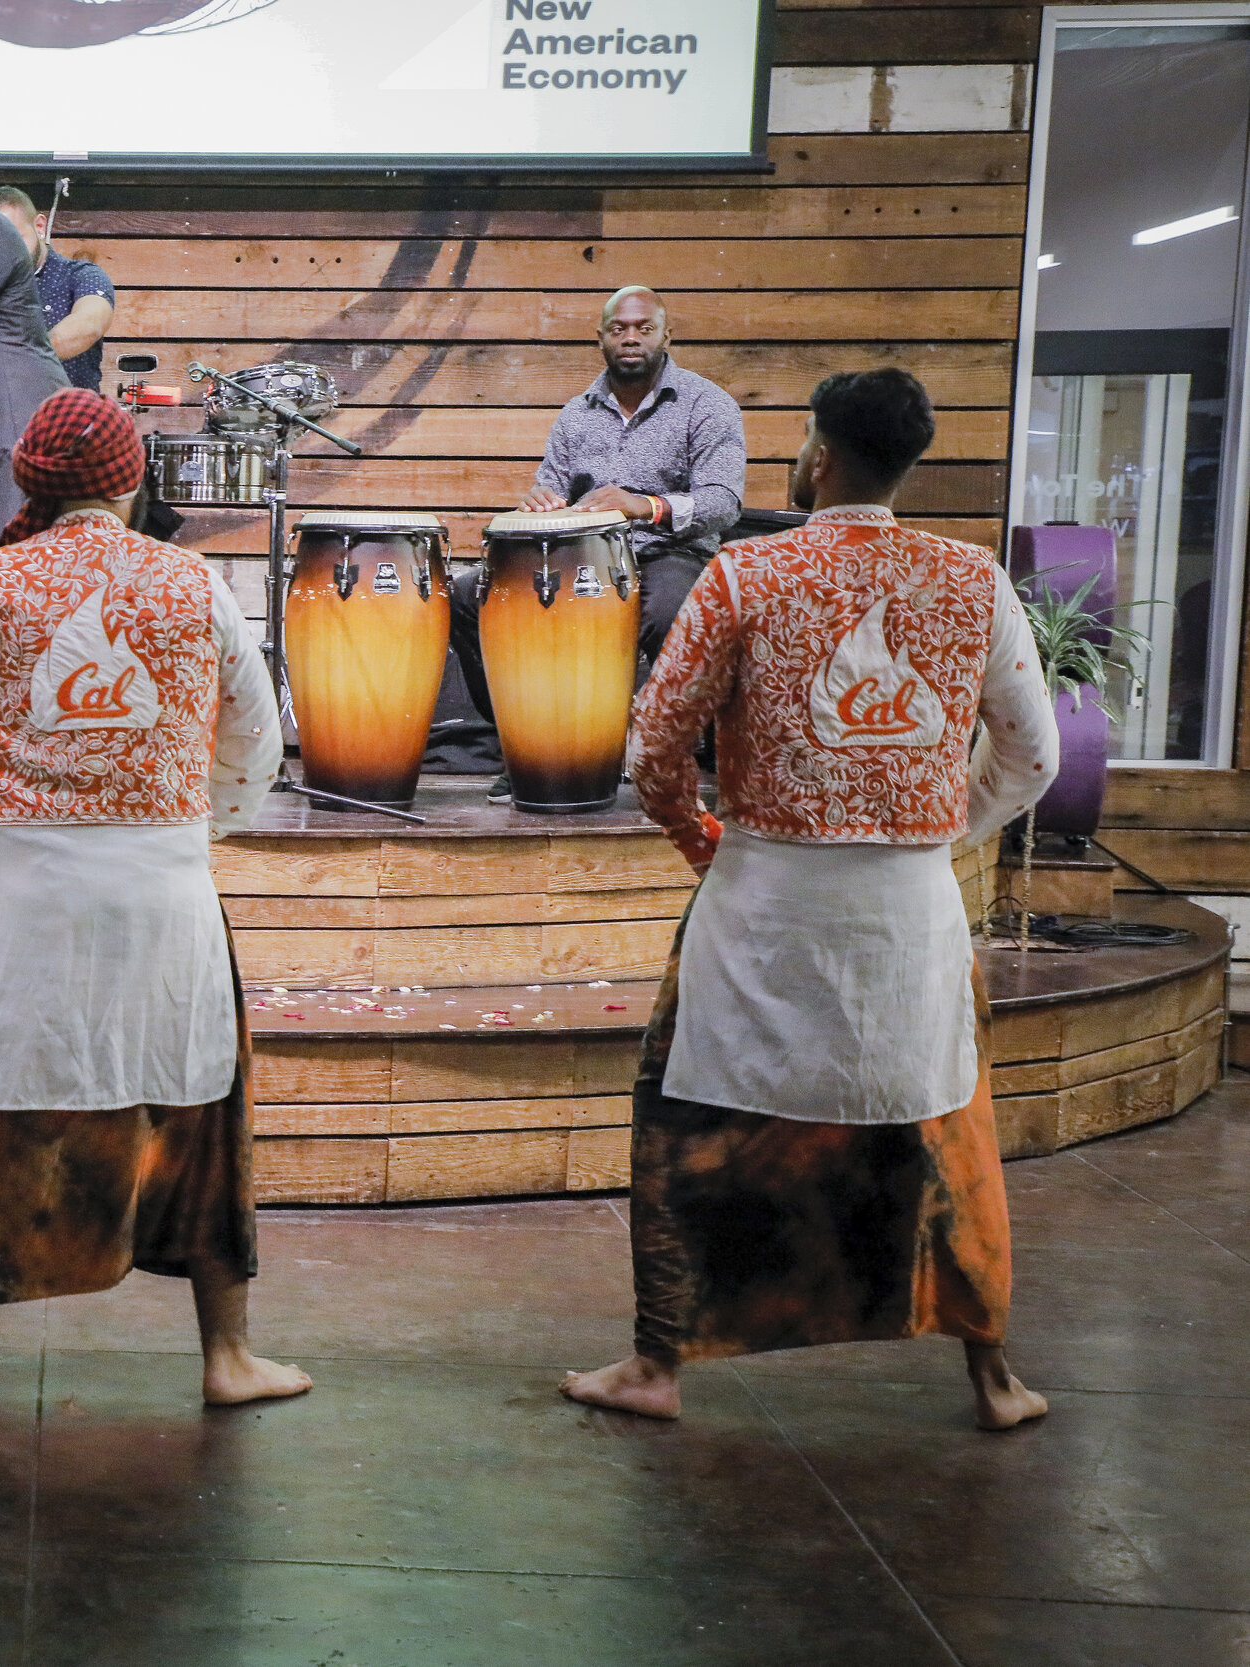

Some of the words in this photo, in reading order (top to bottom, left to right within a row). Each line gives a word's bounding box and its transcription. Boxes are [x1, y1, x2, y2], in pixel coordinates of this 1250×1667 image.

[505, 0, 592, 21] New
[502, 28, 698, 55] American
[502, 62, 688, 95] Economy
[56, 661, 136, 724] Cal
[837, 677, 919, 741] Cal
